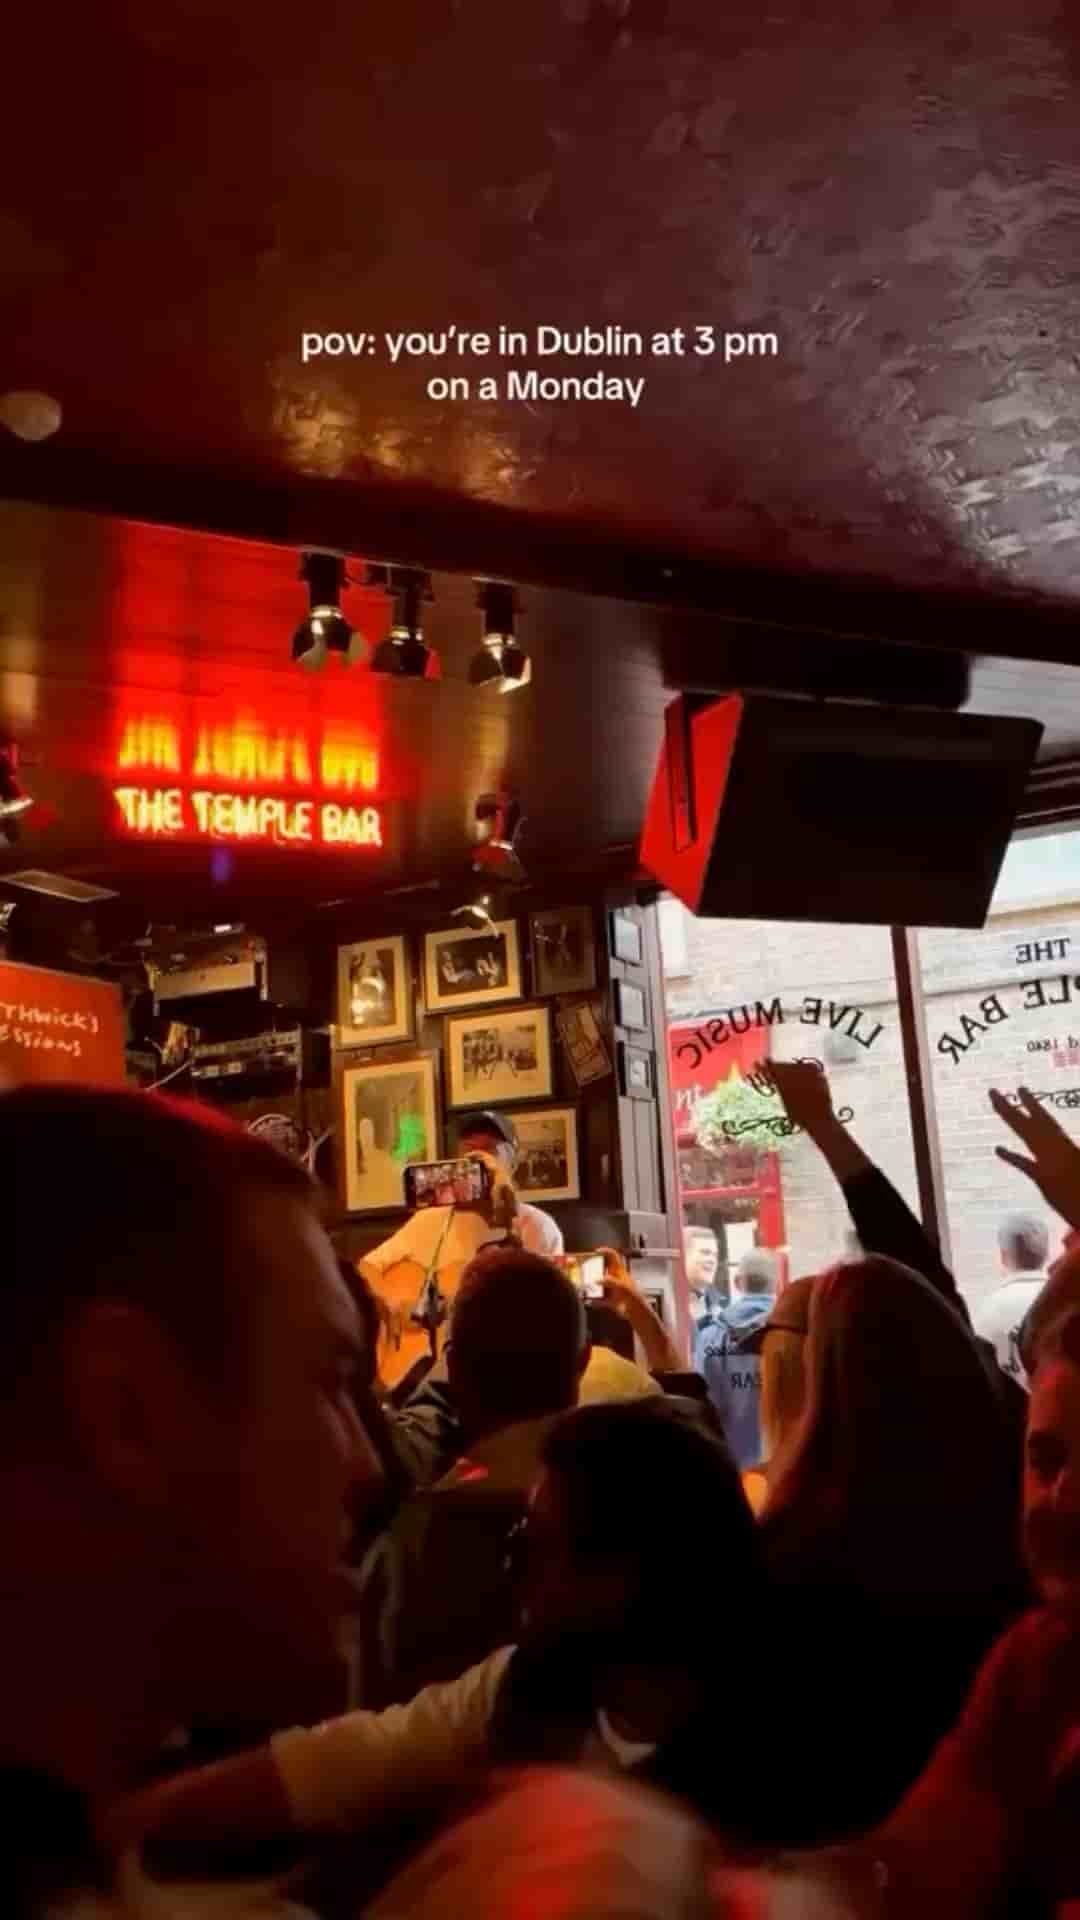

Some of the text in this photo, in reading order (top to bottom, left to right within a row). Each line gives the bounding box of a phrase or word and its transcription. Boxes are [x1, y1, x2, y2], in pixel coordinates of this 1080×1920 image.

[114, 788, 383, 847] THE TEMPLE BAR
